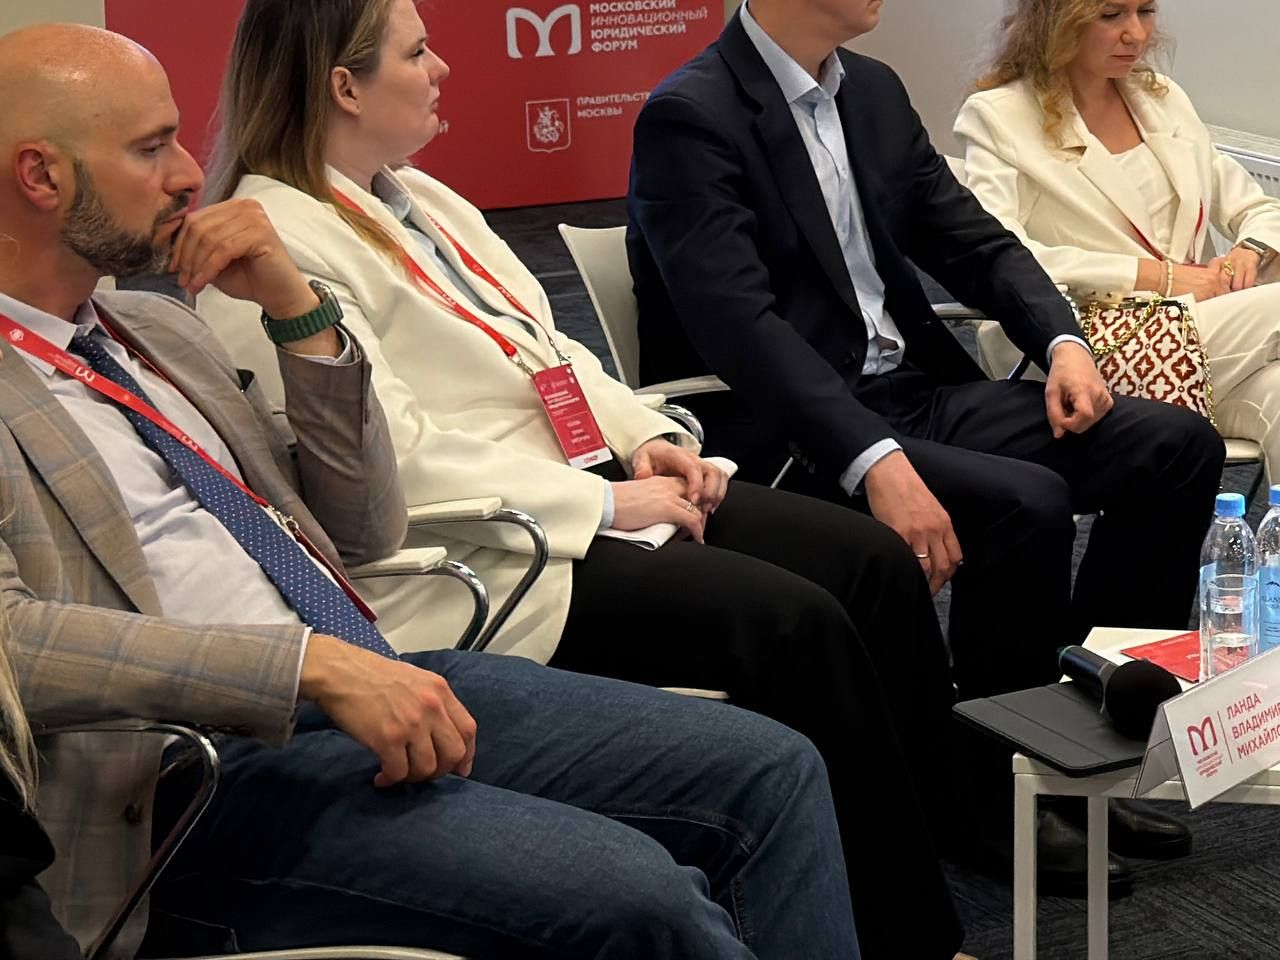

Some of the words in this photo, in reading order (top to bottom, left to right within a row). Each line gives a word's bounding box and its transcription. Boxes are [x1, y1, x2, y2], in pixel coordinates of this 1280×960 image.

[591, 6, 709, 26] ИННОВАЦИОННЫЙ
[591, 21, 687, 40] ЮРИДИЧЕСКИЙ
[591, 40, 638, 52] ФОРУМ
[577, 91, 650, 106] ПРАВИТЕЛЬСТ
[577, 107, 623, 118] МОСКВЫ
[1226, 692, 1262, 721] ЛАНДА
